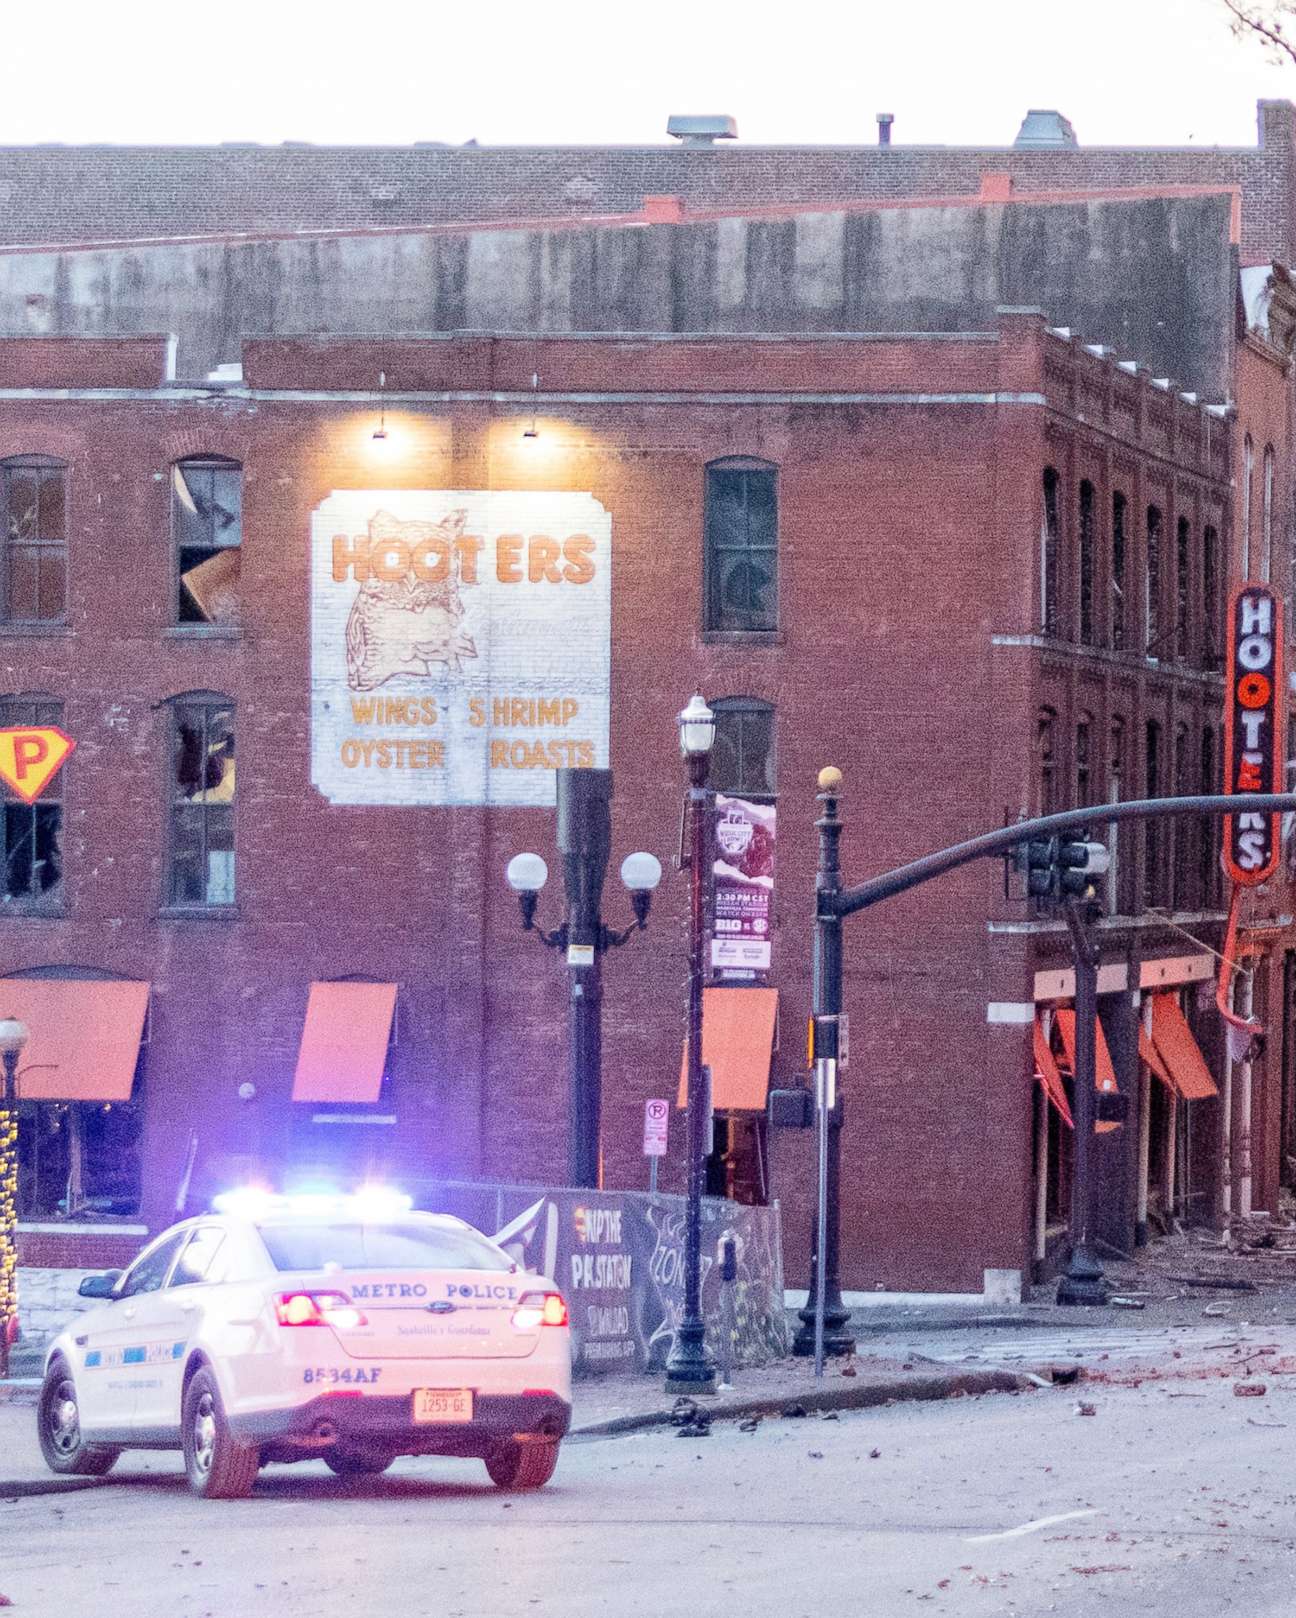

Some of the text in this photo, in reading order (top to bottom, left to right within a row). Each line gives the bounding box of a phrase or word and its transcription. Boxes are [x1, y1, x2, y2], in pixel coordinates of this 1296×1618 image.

[332, 534, 596, 584] HOOTERS
[352, 696, 438, 726] WINGS
[13, 735, 49, 780] P
[341, 739, 596, 769] OYSTER ROASTS
[716, 893, 769, 903] 2:30 PM CST
[604, 1210, 621, 1244] THE
[352, 1284, 518, 1300] METRO POLICE
[303, 1368, 382, 1384] 8534AF
